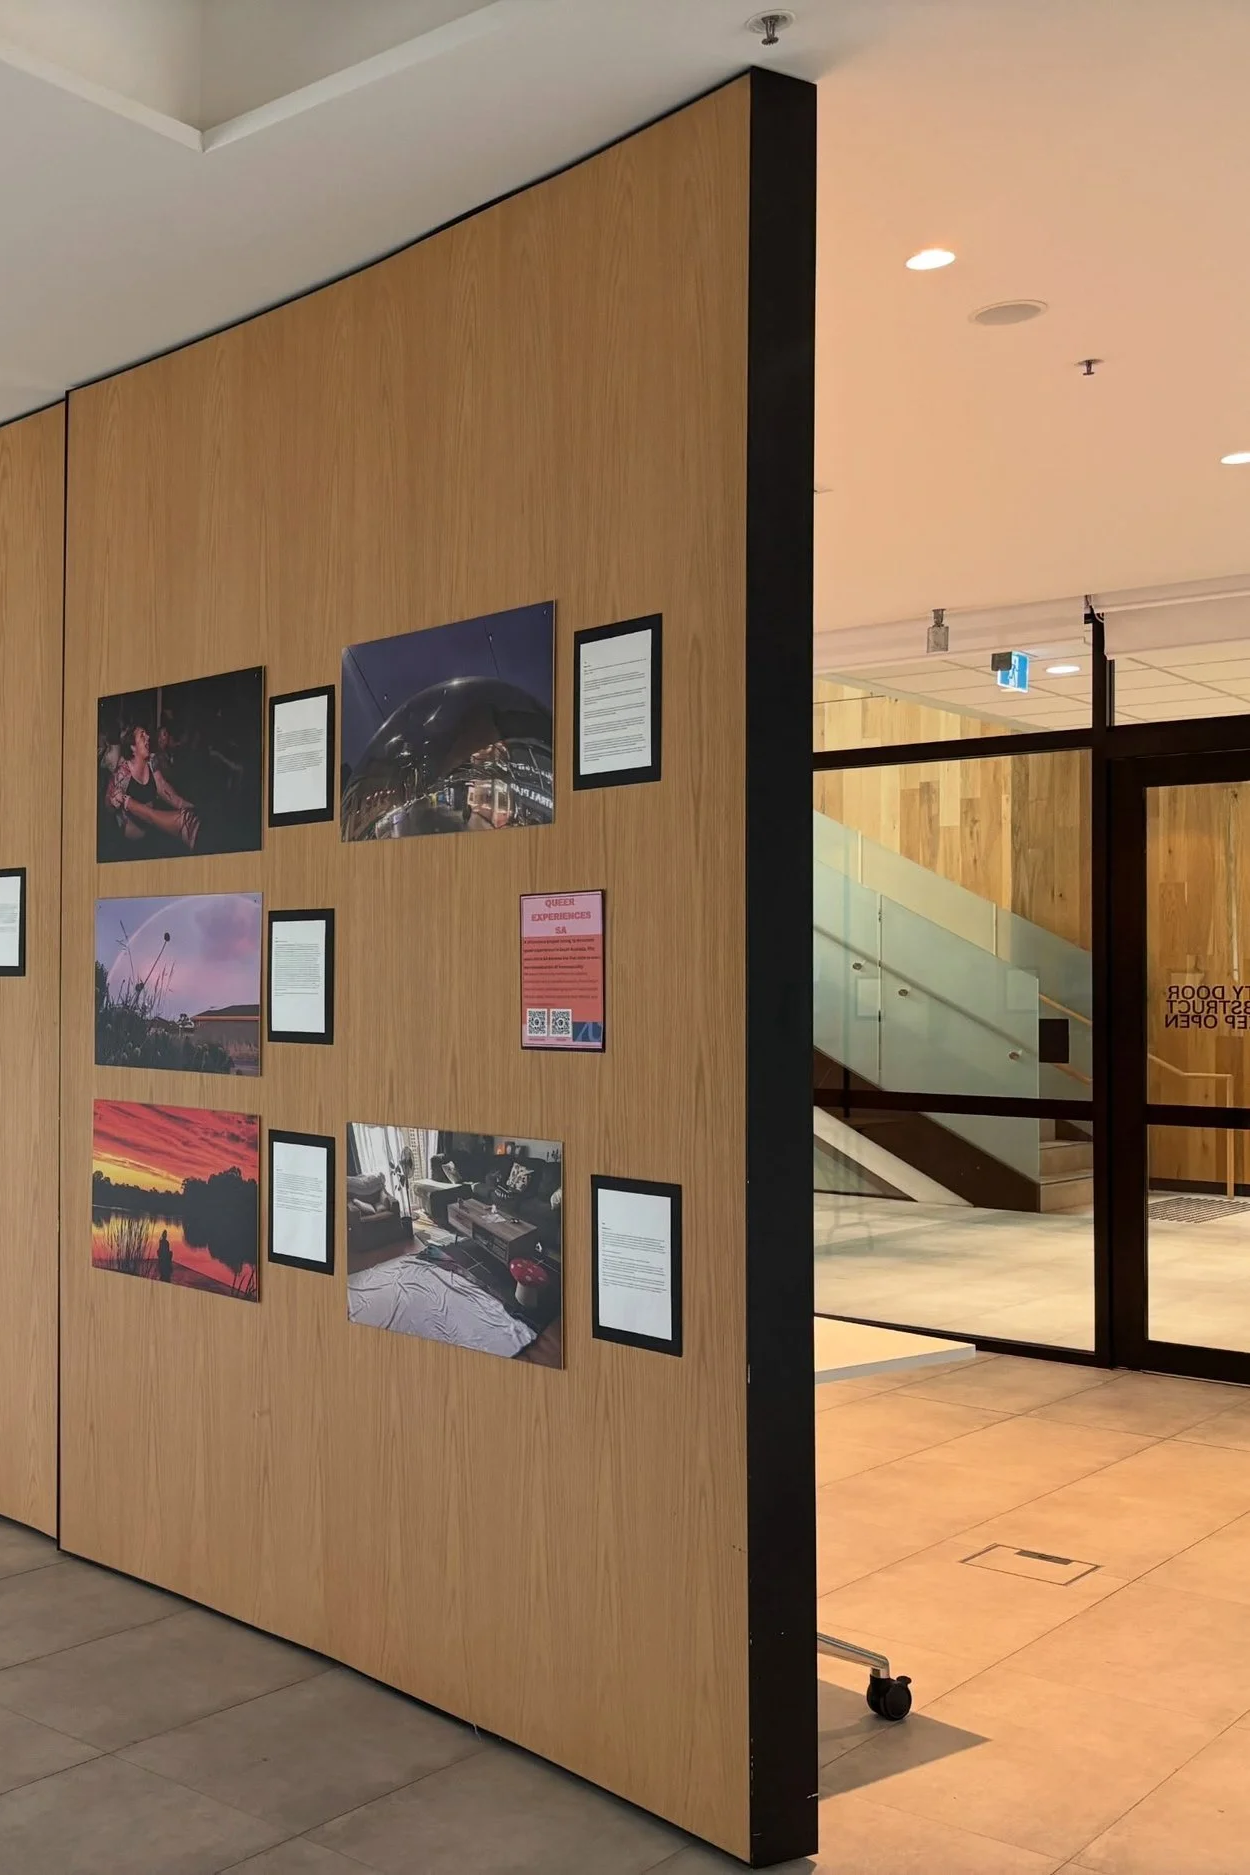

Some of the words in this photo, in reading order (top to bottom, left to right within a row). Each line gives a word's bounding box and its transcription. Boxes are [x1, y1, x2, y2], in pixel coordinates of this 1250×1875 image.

[545, 897, 575, 908] QUEER
[531, 911, 592, 921] EXPERIENCES
[554, 926, 567, 934] SA
